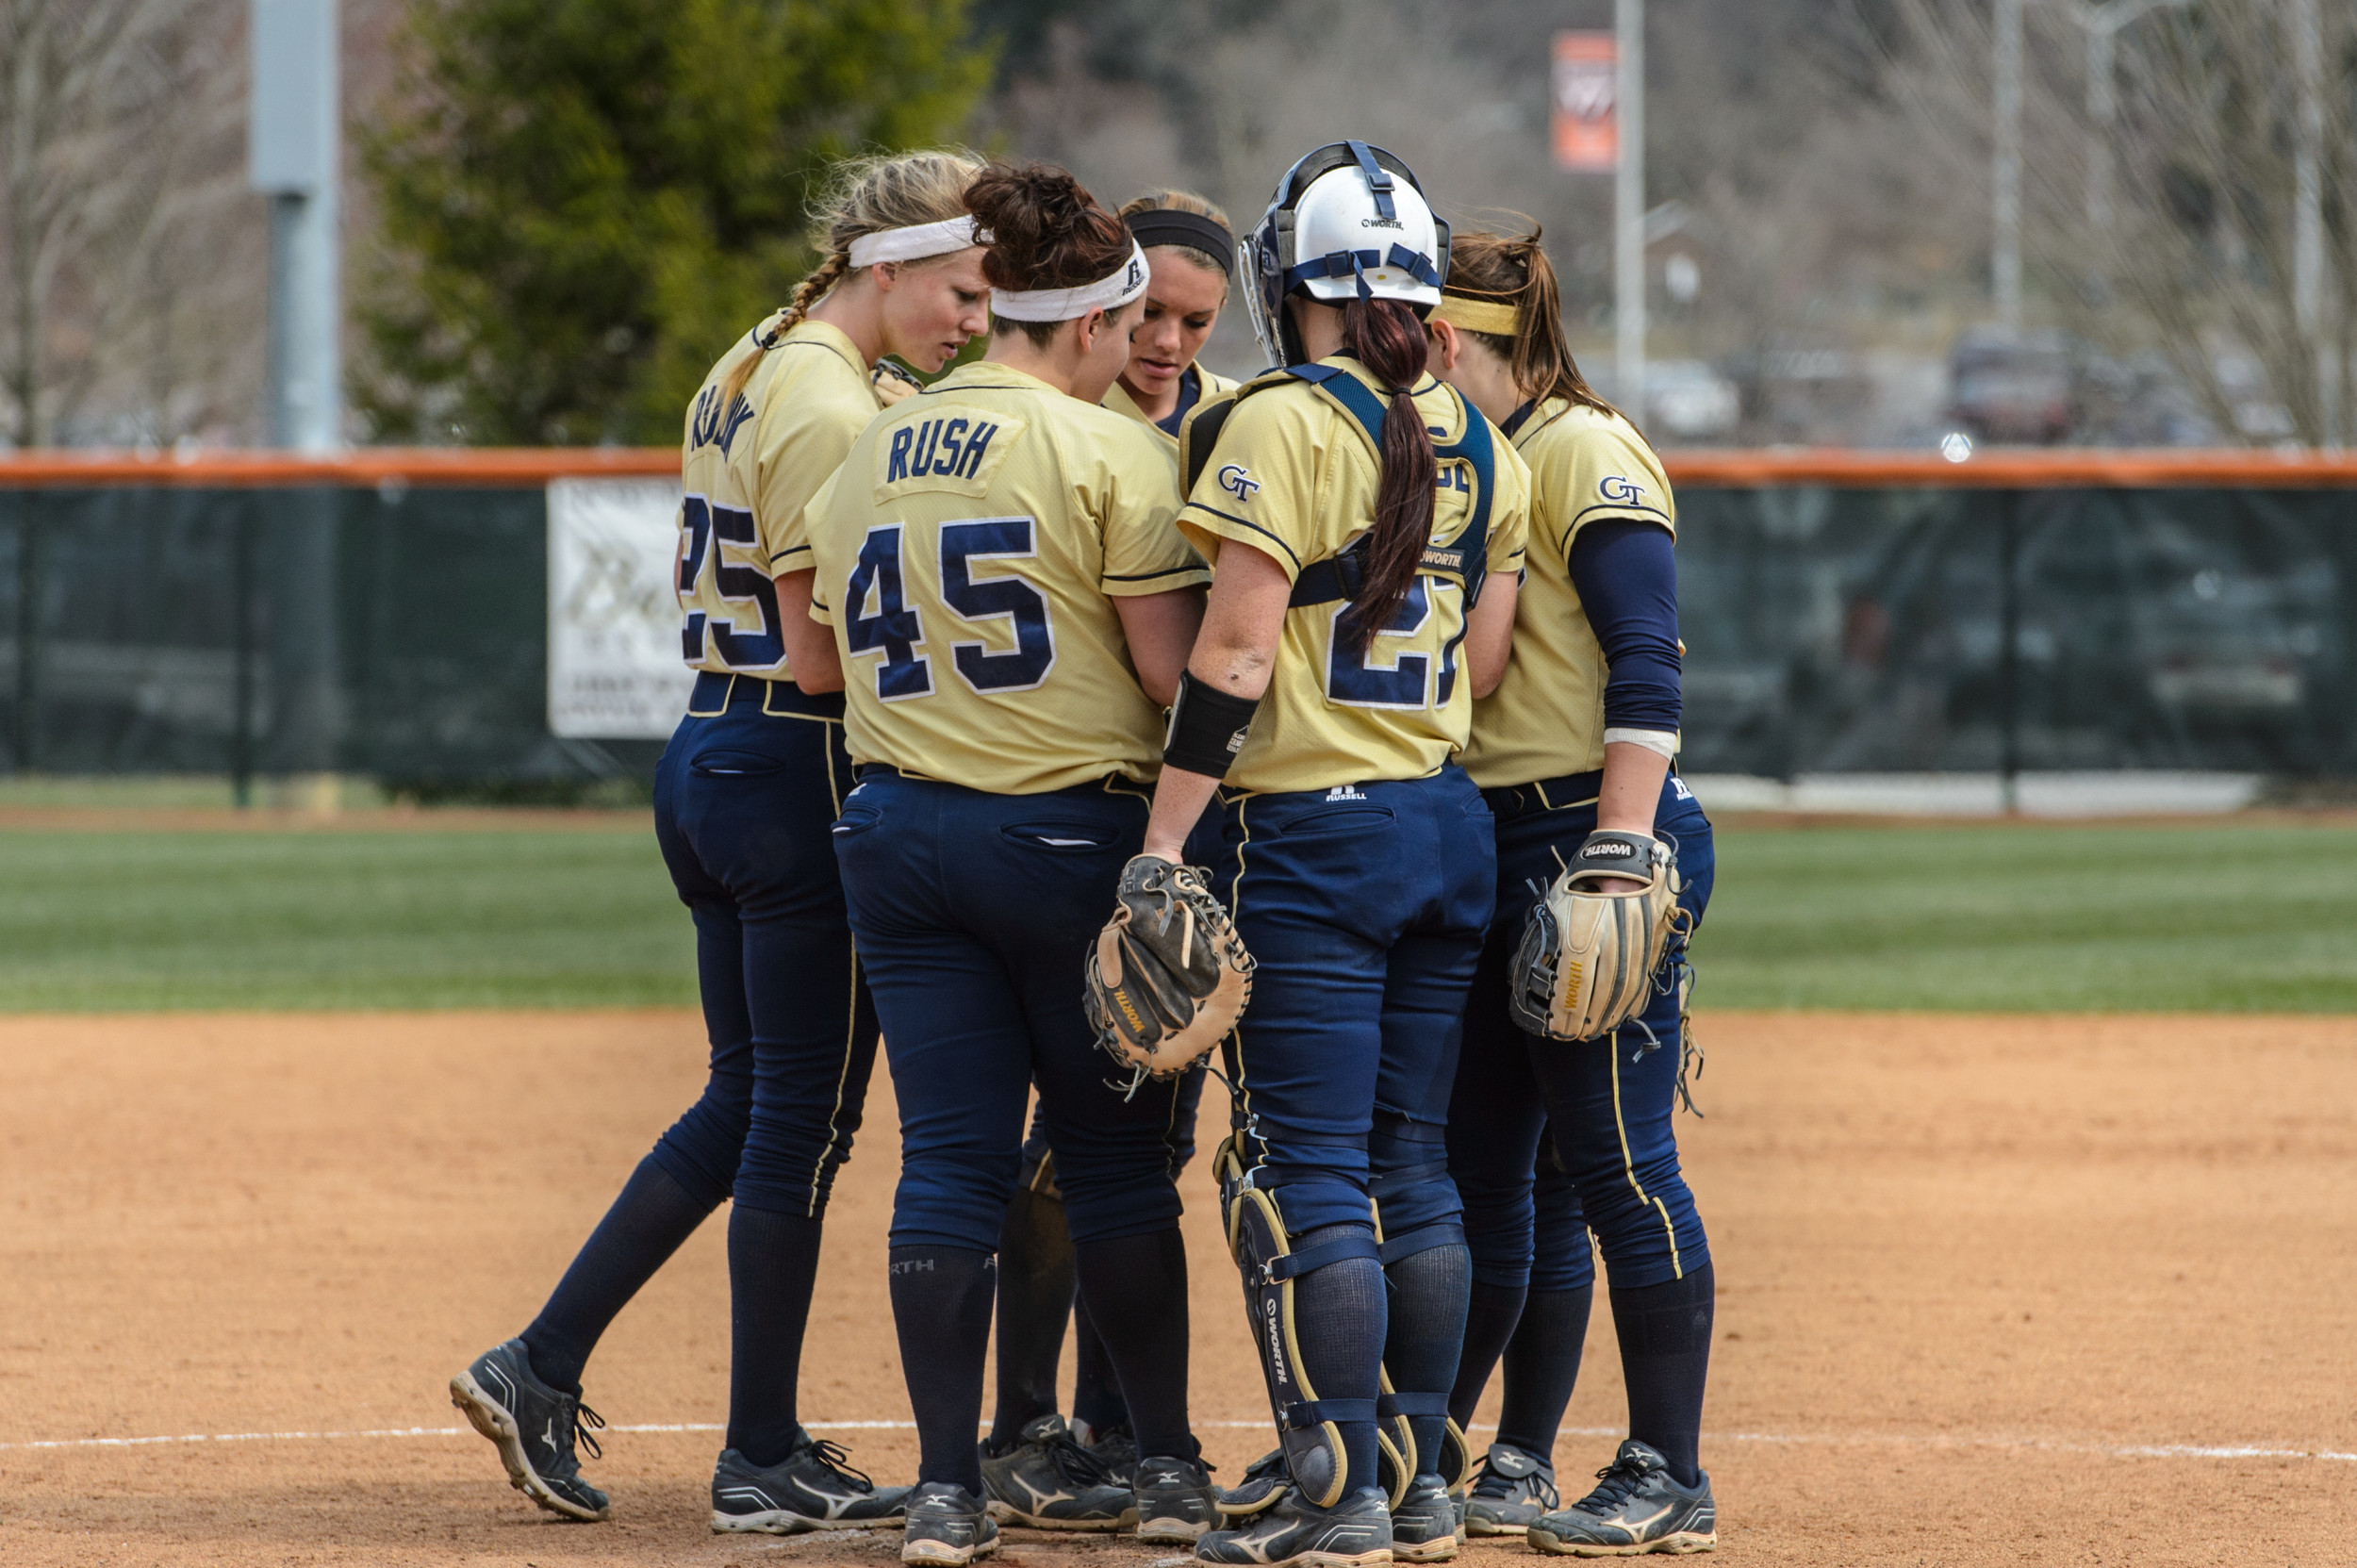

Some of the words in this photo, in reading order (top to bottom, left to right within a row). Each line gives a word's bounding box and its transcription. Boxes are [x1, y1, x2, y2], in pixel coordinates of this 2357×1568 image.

[1370, 219, 1403, 230] WORTH
[887, 418, 998, 484] RUSH
[1217, 463, 1261, 503] GT
[1598, 474, 1647, 506] GT
[1425, 550, 1461, 568] WORTH
[845, 515, 1057, 703] 45
[1326, 792, 1367, 802] RUSSELL
[1564, 959, 1583, 1009] WORTH
[1113, 990, 1146, 1033] WORTH
[1268, 1316, 1288, 1384] WORTH
